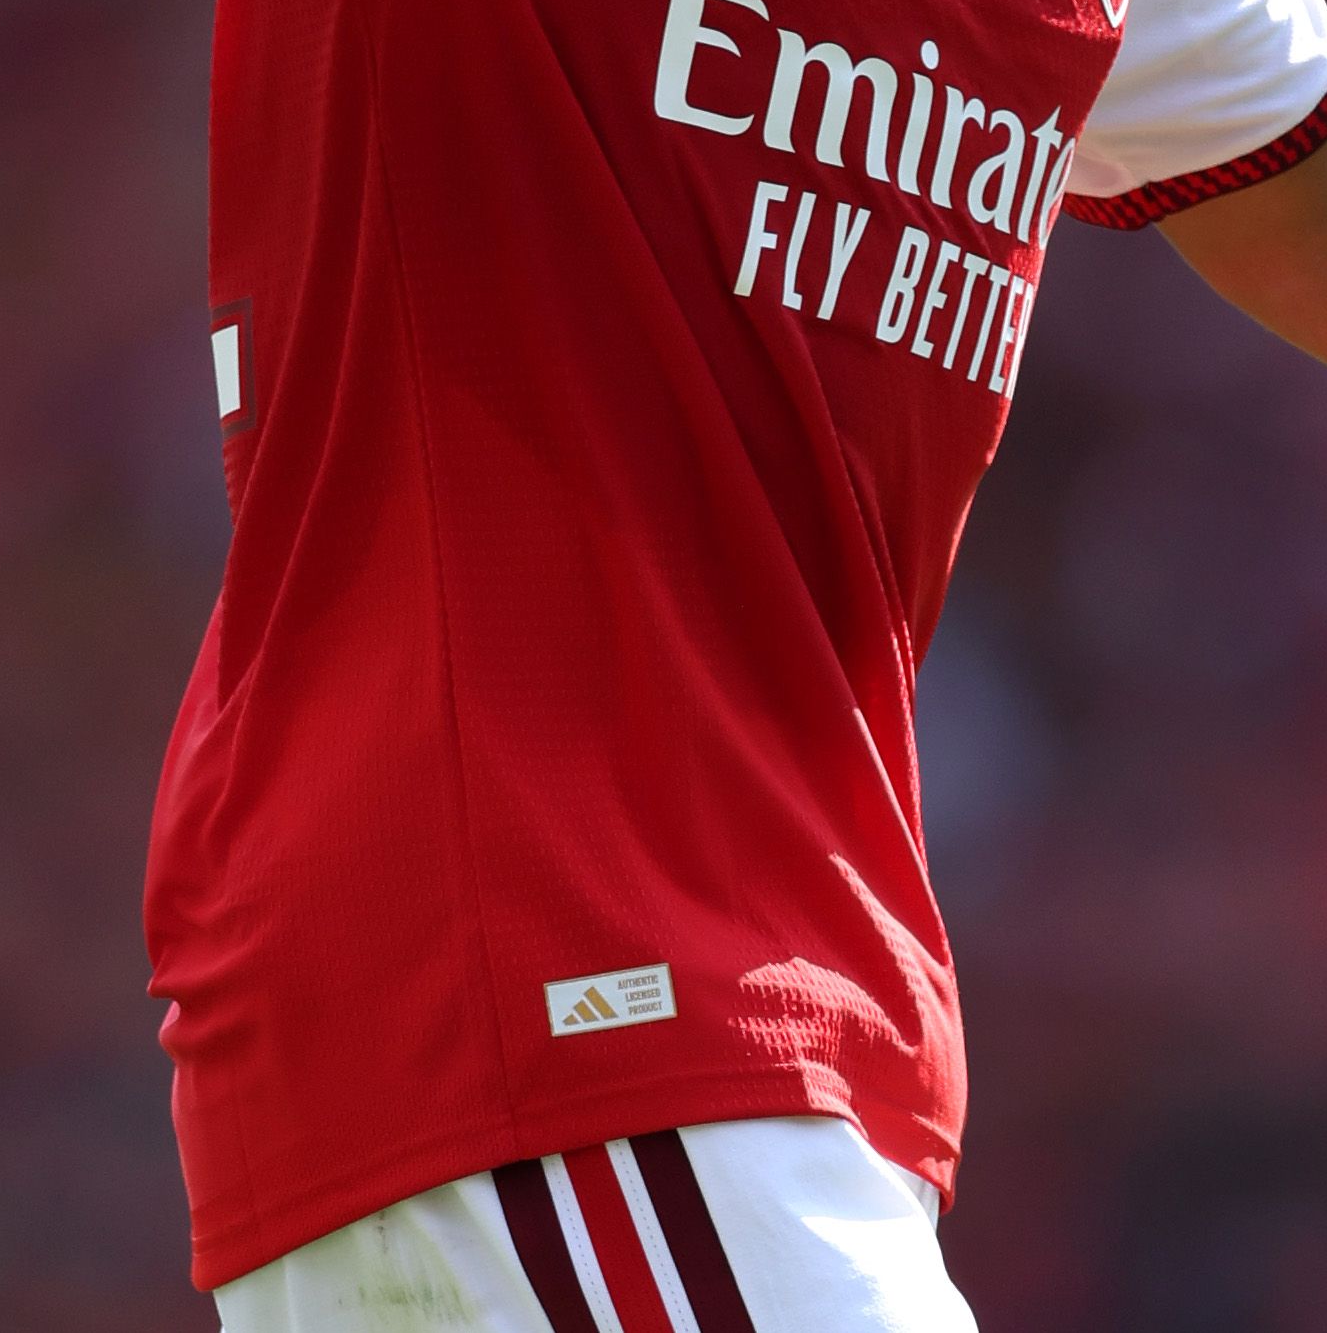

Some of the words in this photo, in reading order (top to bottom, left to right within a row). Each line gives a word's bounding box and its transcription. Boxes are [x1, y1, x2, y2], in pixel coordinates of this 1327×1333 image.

[733, 180, 871, 321] FLY
[618, 975, 659, 990] AUTHENTIC
[628, 1001, 662, 1015] PRODUCT
